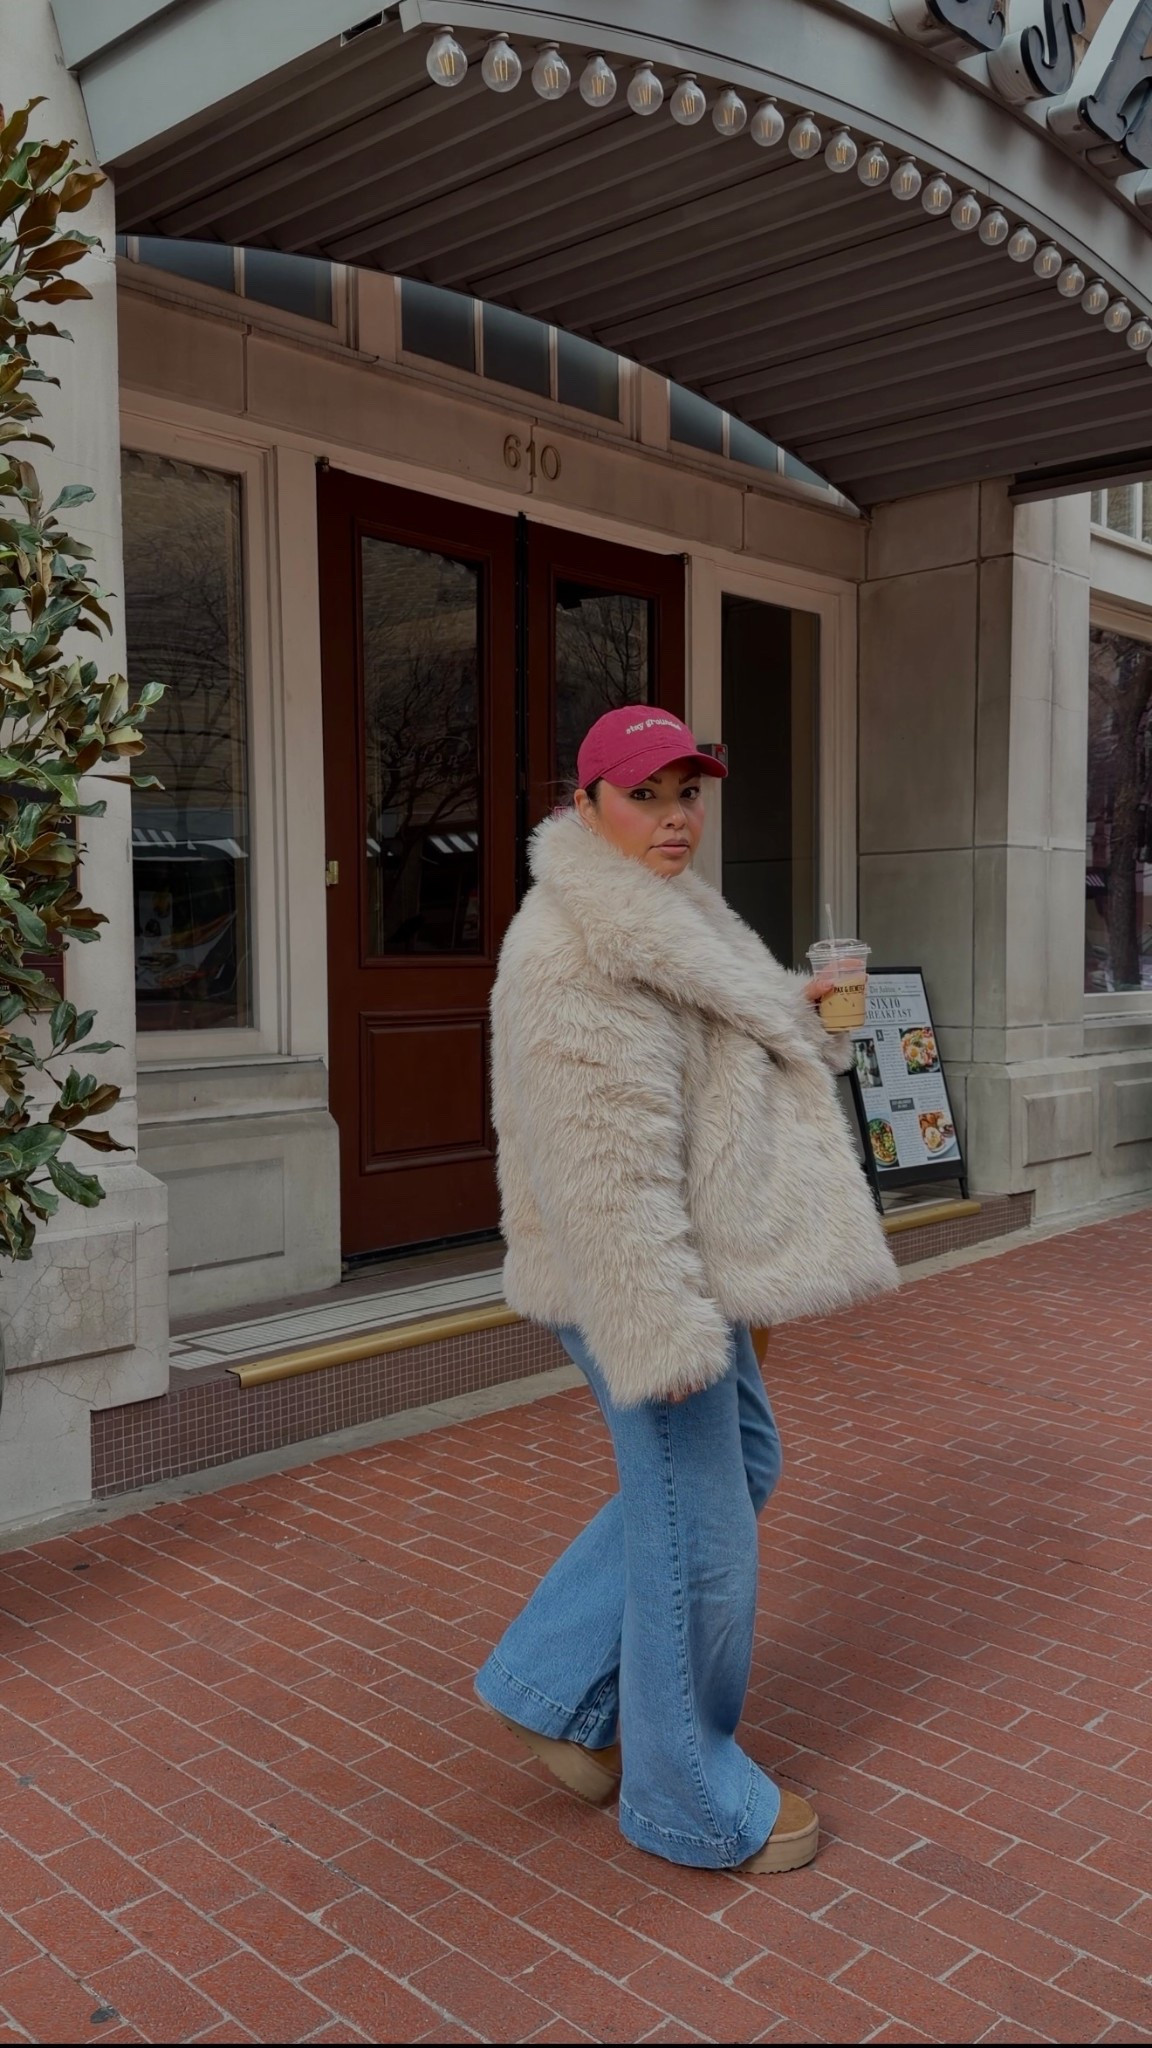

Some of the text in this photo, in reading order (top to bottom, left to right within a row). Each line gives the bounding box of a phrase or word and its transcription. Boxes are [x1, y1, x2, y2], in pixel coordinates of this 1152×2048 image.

[502, 433, 562, 482] 610
[625, 721, 644, 735] stay
[870, 998, 901, 1009] SIX10
[866, 1009, 912, 1020] REAKFAST
